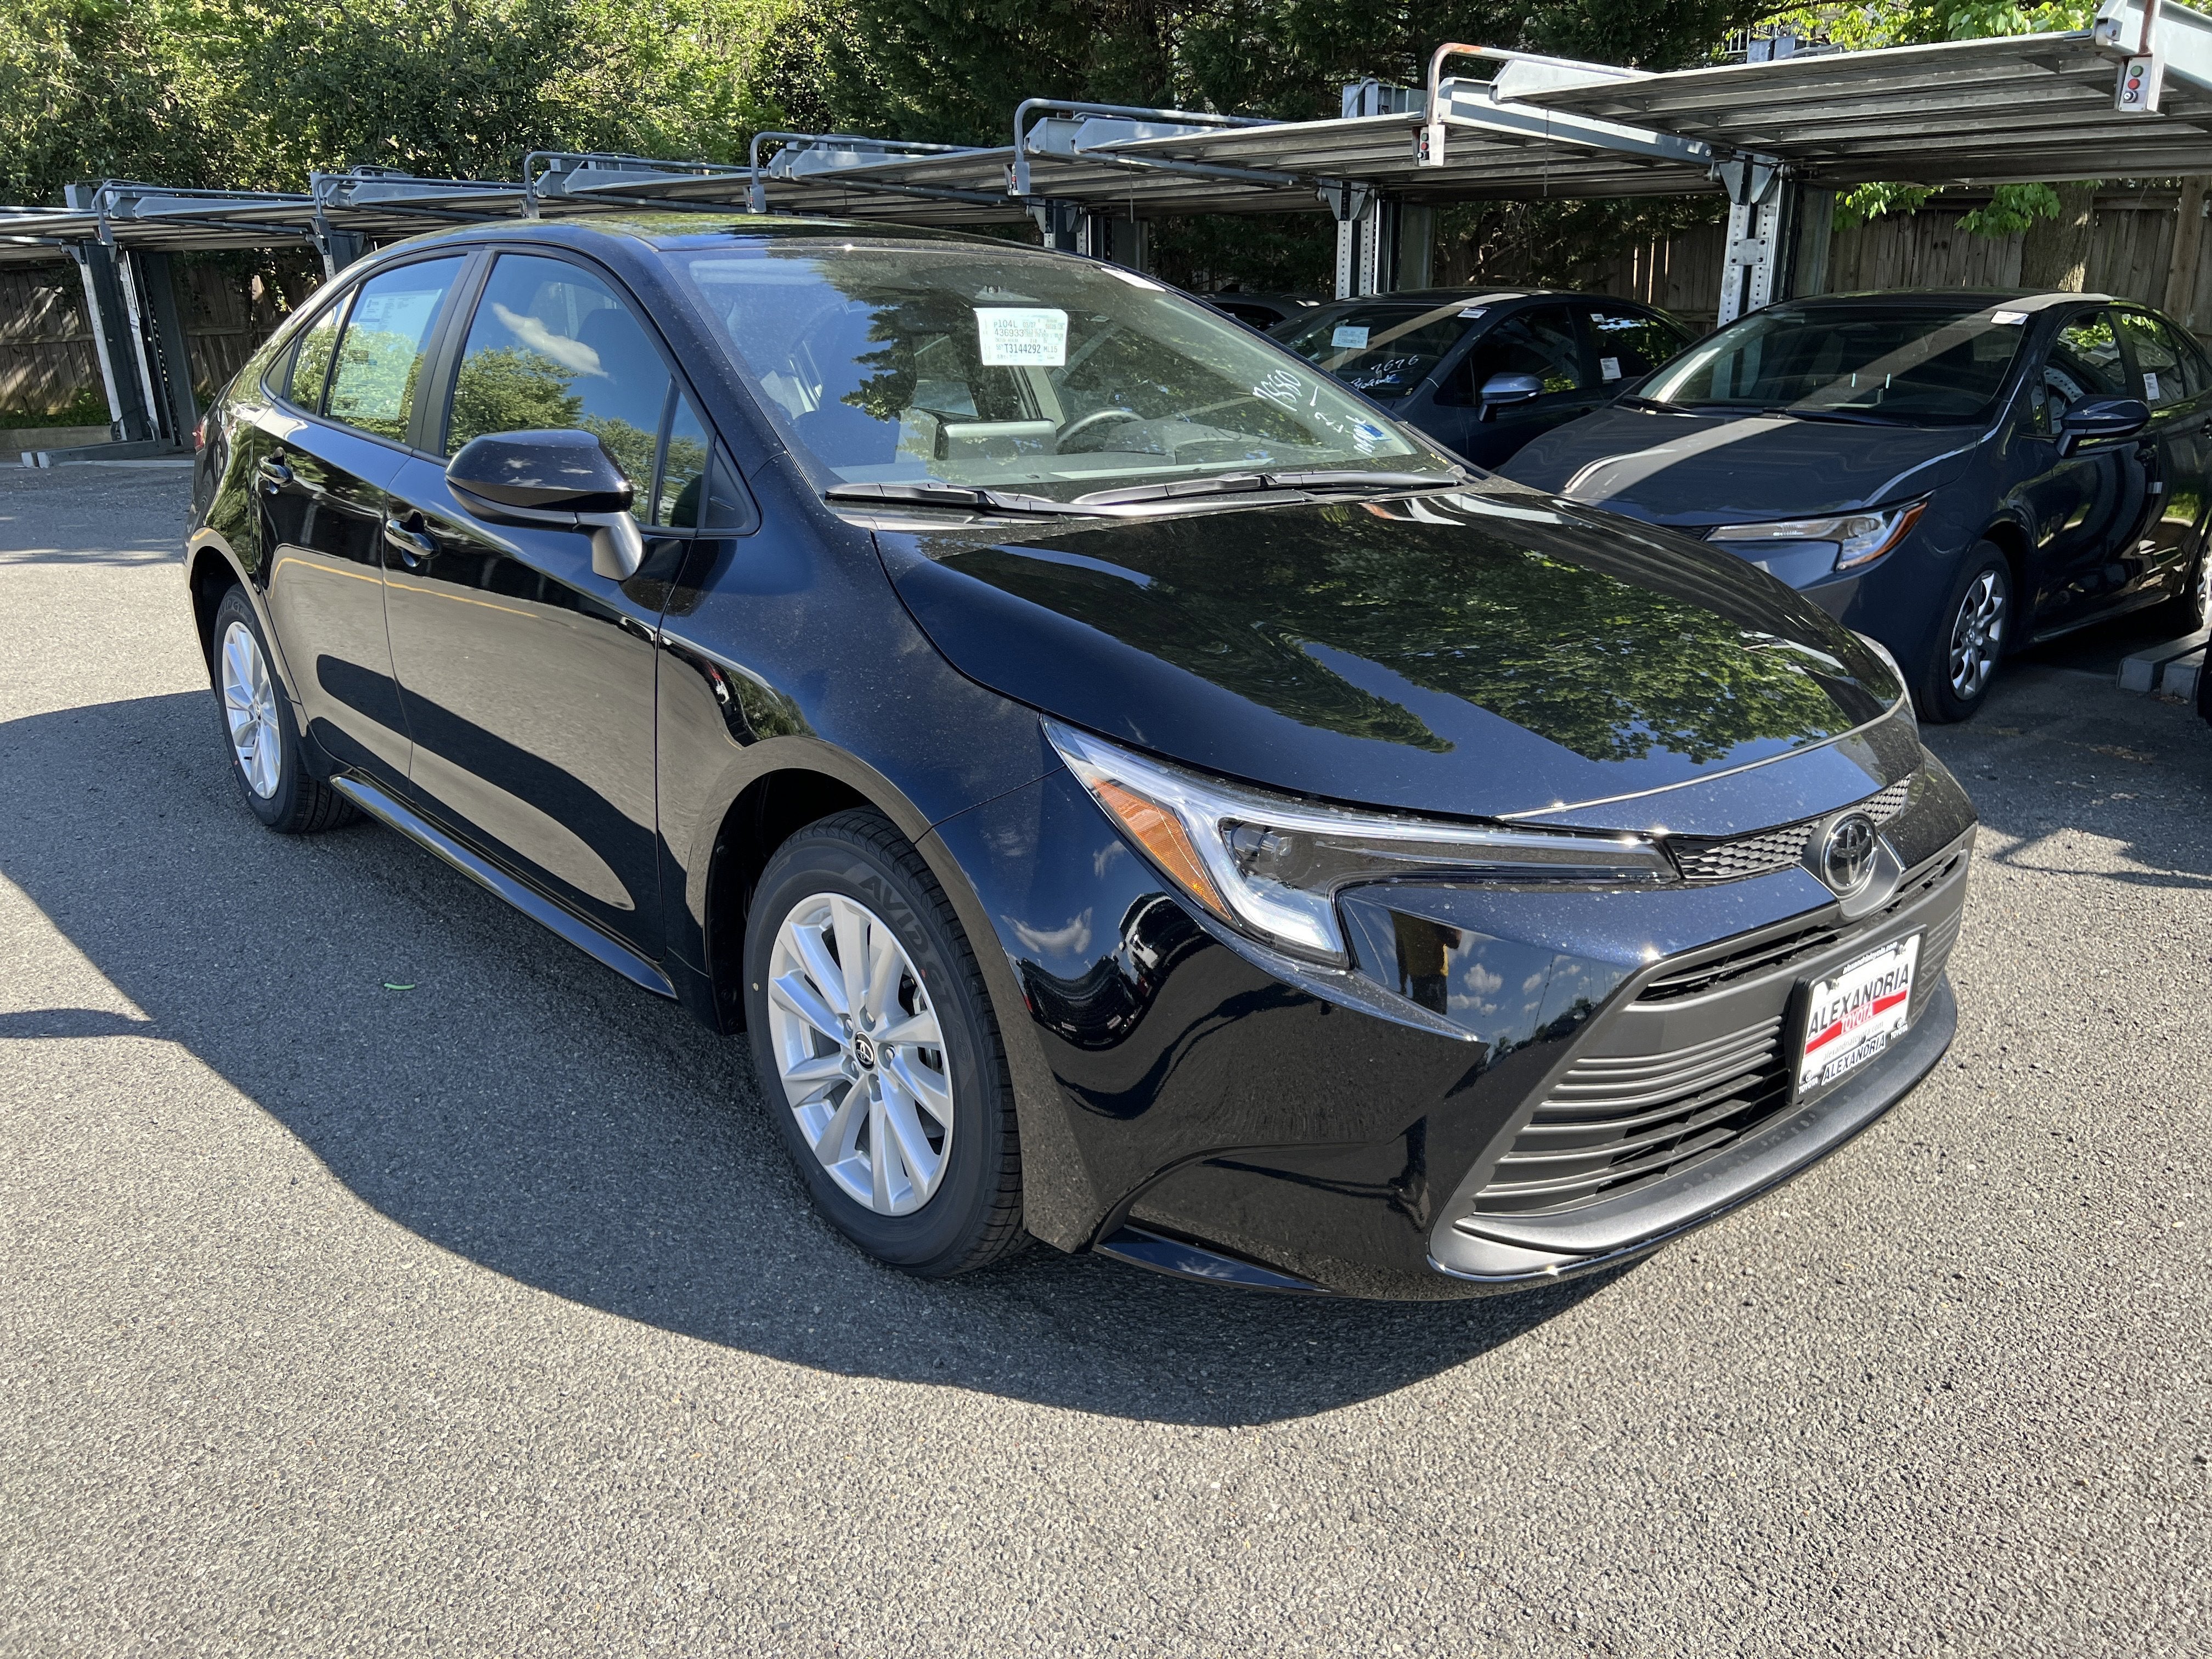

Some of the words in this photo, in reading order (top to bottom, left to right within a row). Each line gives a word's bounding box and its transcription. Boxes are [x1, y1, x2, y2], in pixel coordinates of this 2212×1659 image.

[1004, 344, 1041, 354] T3144292
[858, 874, 928, 953] AVID
[1807, 963, 1909, 1039] ALEXANDRIA
[1841, 1003, 1873, 1034] TOYOTA
[1891, 1024, 1908, 1040] TOYOTA
[1822, 1034, 1885, 1084] ALEXANDRIA
[1798, 1077, 1818, 1094] TOYOTA
